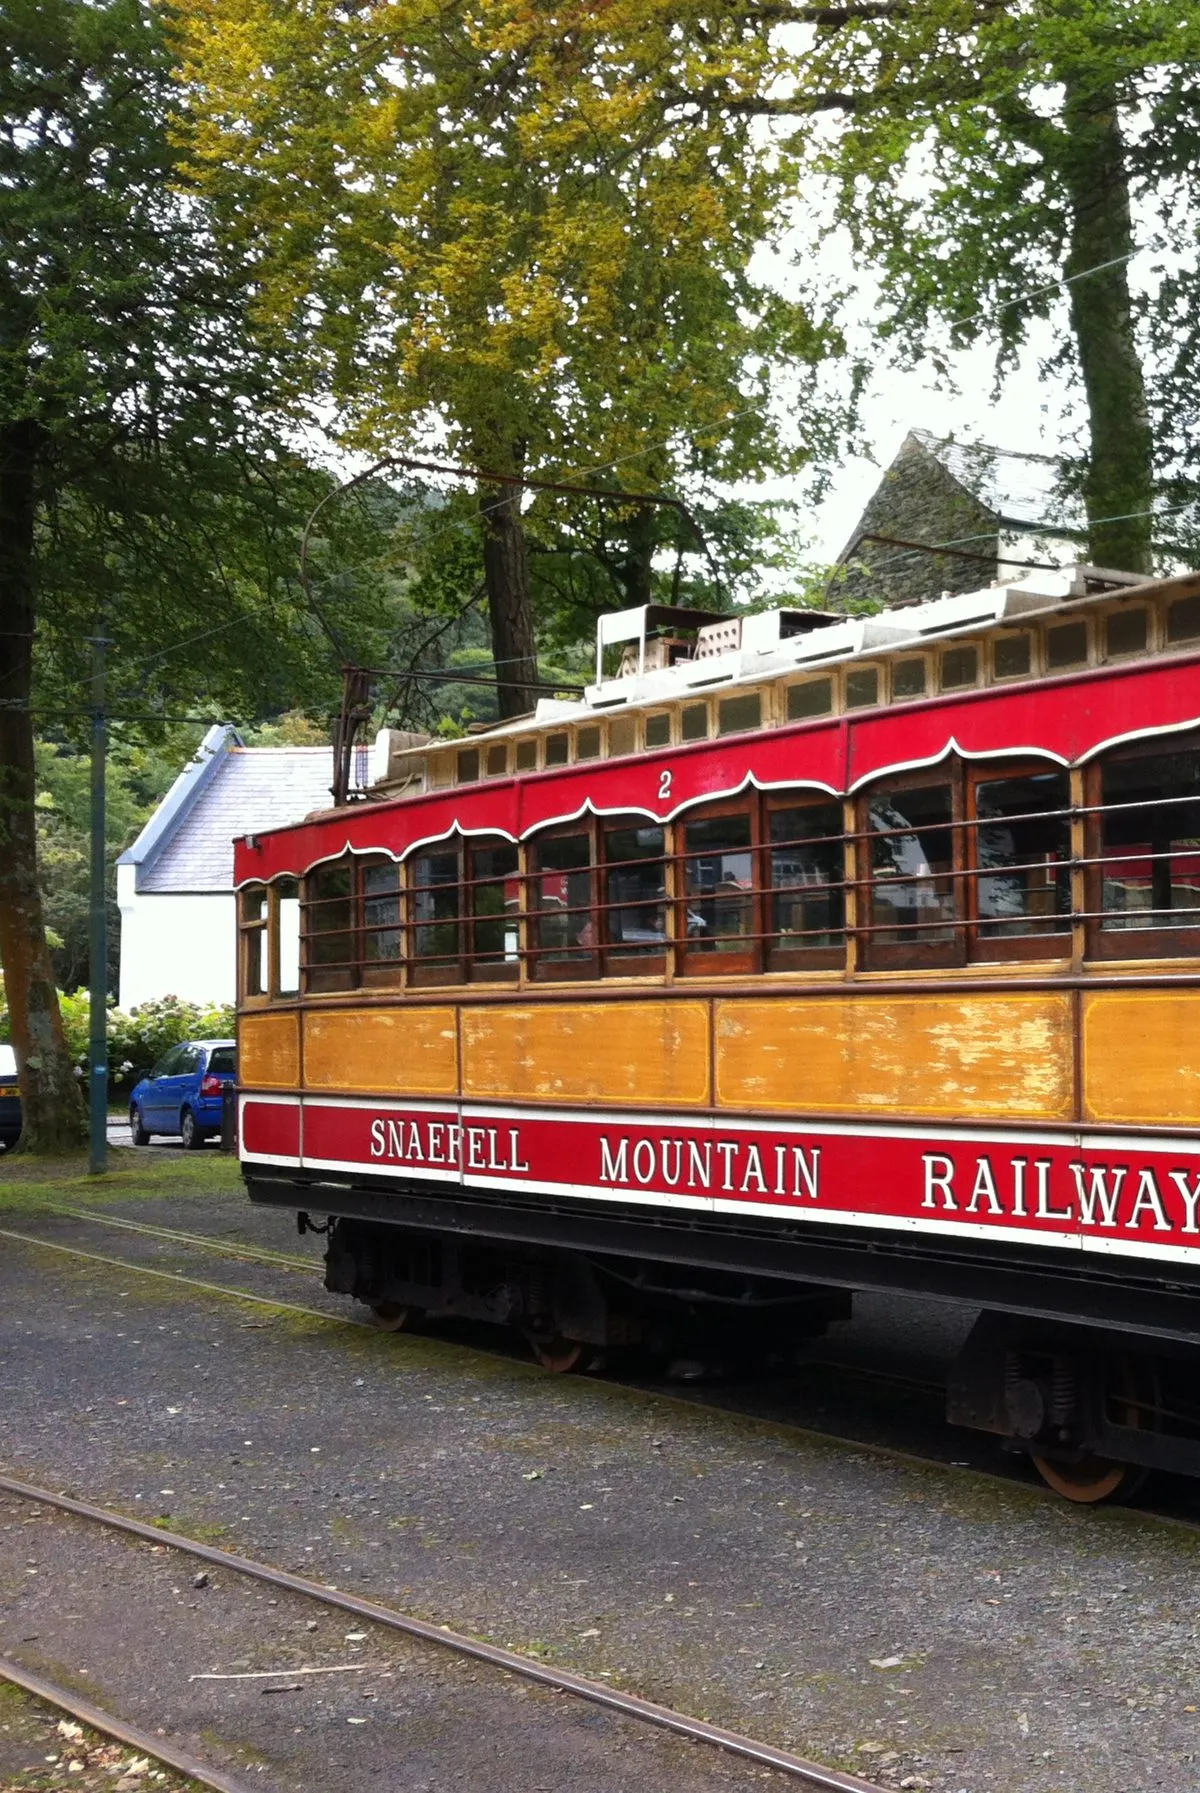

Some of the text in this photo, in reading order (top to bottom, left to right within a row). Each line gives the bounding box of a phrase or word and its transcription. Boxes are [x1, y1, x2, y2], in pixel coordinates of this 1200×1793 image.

[657, 770, 673, 800] 2
[370, 1119, 530, 1173] SNAEFELL
[599, 1137, 823, 1200] MOUNTAIN
